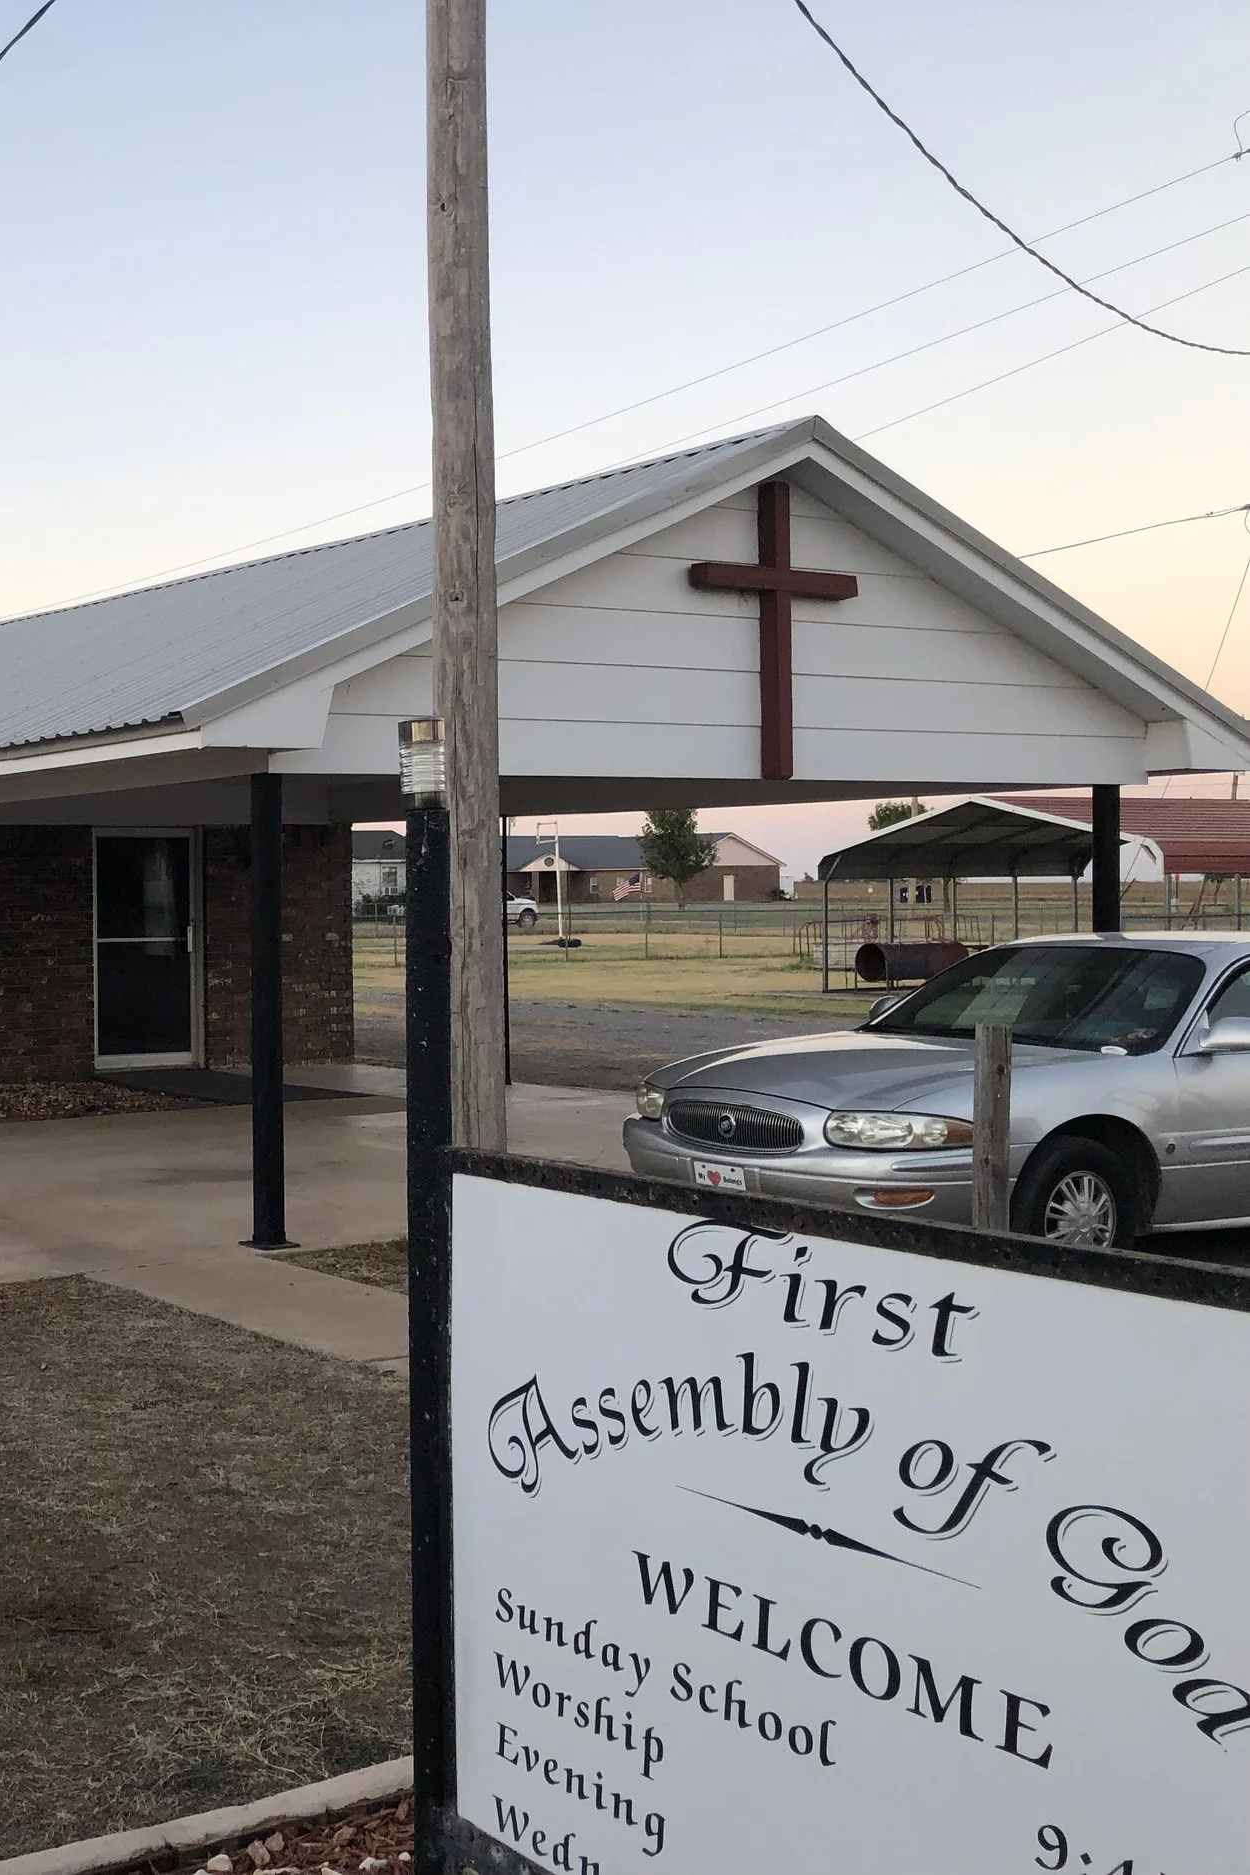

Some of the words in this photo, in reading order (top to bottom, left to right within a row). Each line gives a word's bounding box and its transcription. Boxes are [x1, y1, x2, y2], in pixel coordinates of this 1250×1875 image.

[697, 1172, 706, 1182] My
[723, 1175, 743, 1186] Belongs
[667, 1219, 981, 1364] First
[488, 1351, 875, 1496] Assembly
[893, 1439, 1057, 1540] of
[493, 1652, 664, 1781] Worship
[495, 1587, 651, 1698] Sunday
[670, 1662, 837, 1767] School
[631, 1550, 1054, 1770] WELCOME
[495, 1721, 666, 1857] Evening
